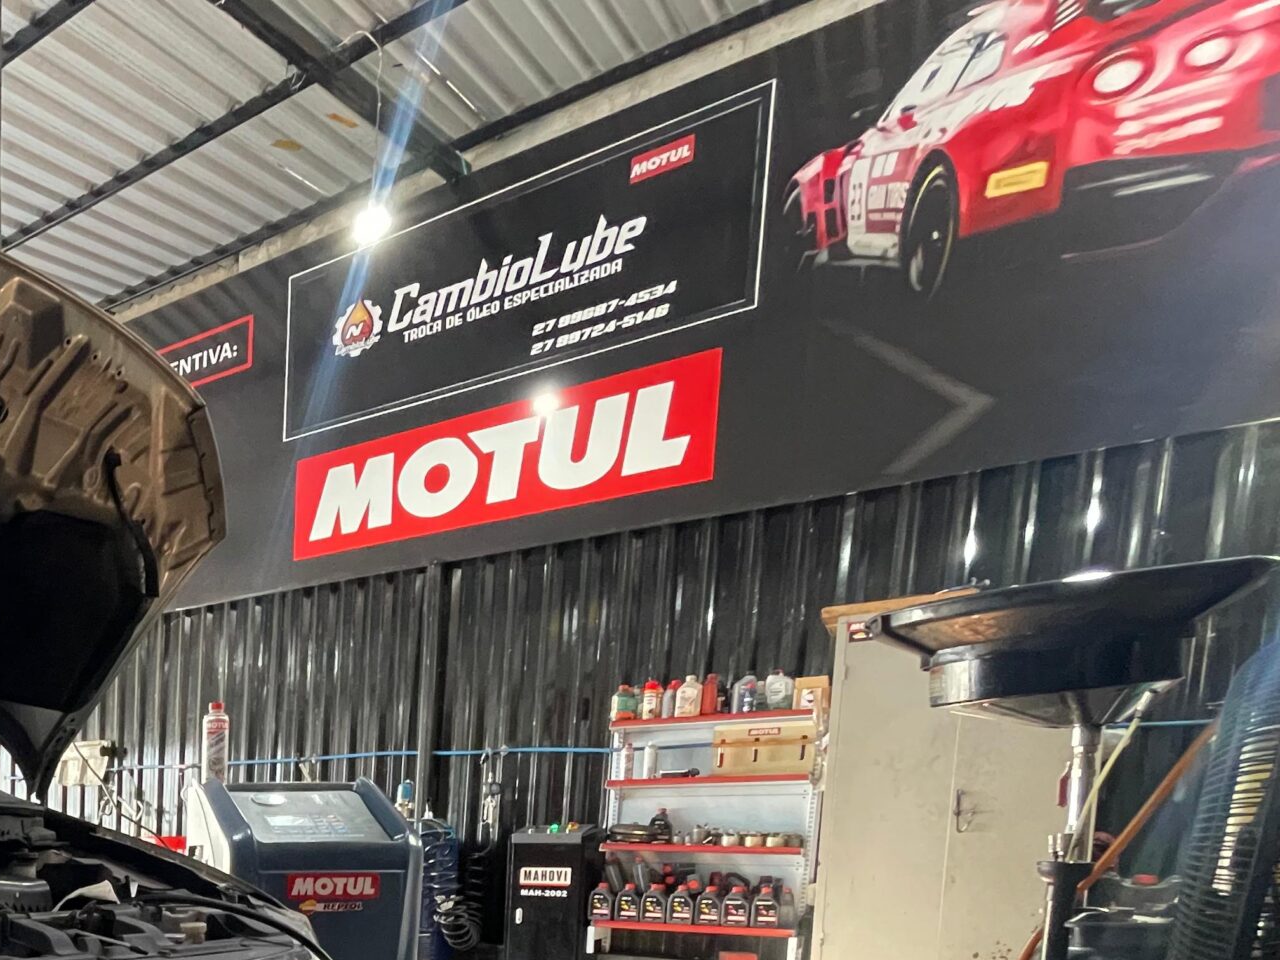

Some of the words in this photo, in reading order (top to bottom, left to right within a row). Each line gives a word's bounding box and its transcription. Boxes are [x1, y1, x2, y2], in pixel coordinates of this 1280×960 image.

[630, 145, 691, 178] MOTUL
[387, 214, 647, 333] CambioLube
[403, 321, 442, 343] TROCA
[446, 315, 463, 330] DE
[466, 303, 500, 322] ÓLEO
[504, 258, 623, 310] ESPECIALIZADA
[532, 319, 557, 336] 27
[530, 338, 555, 355] 27
[309, 380, 691, 542] MOTUL
[291, 877, 375, 896] MOTUL
[523, 870, 568, 882] MAHOVI
